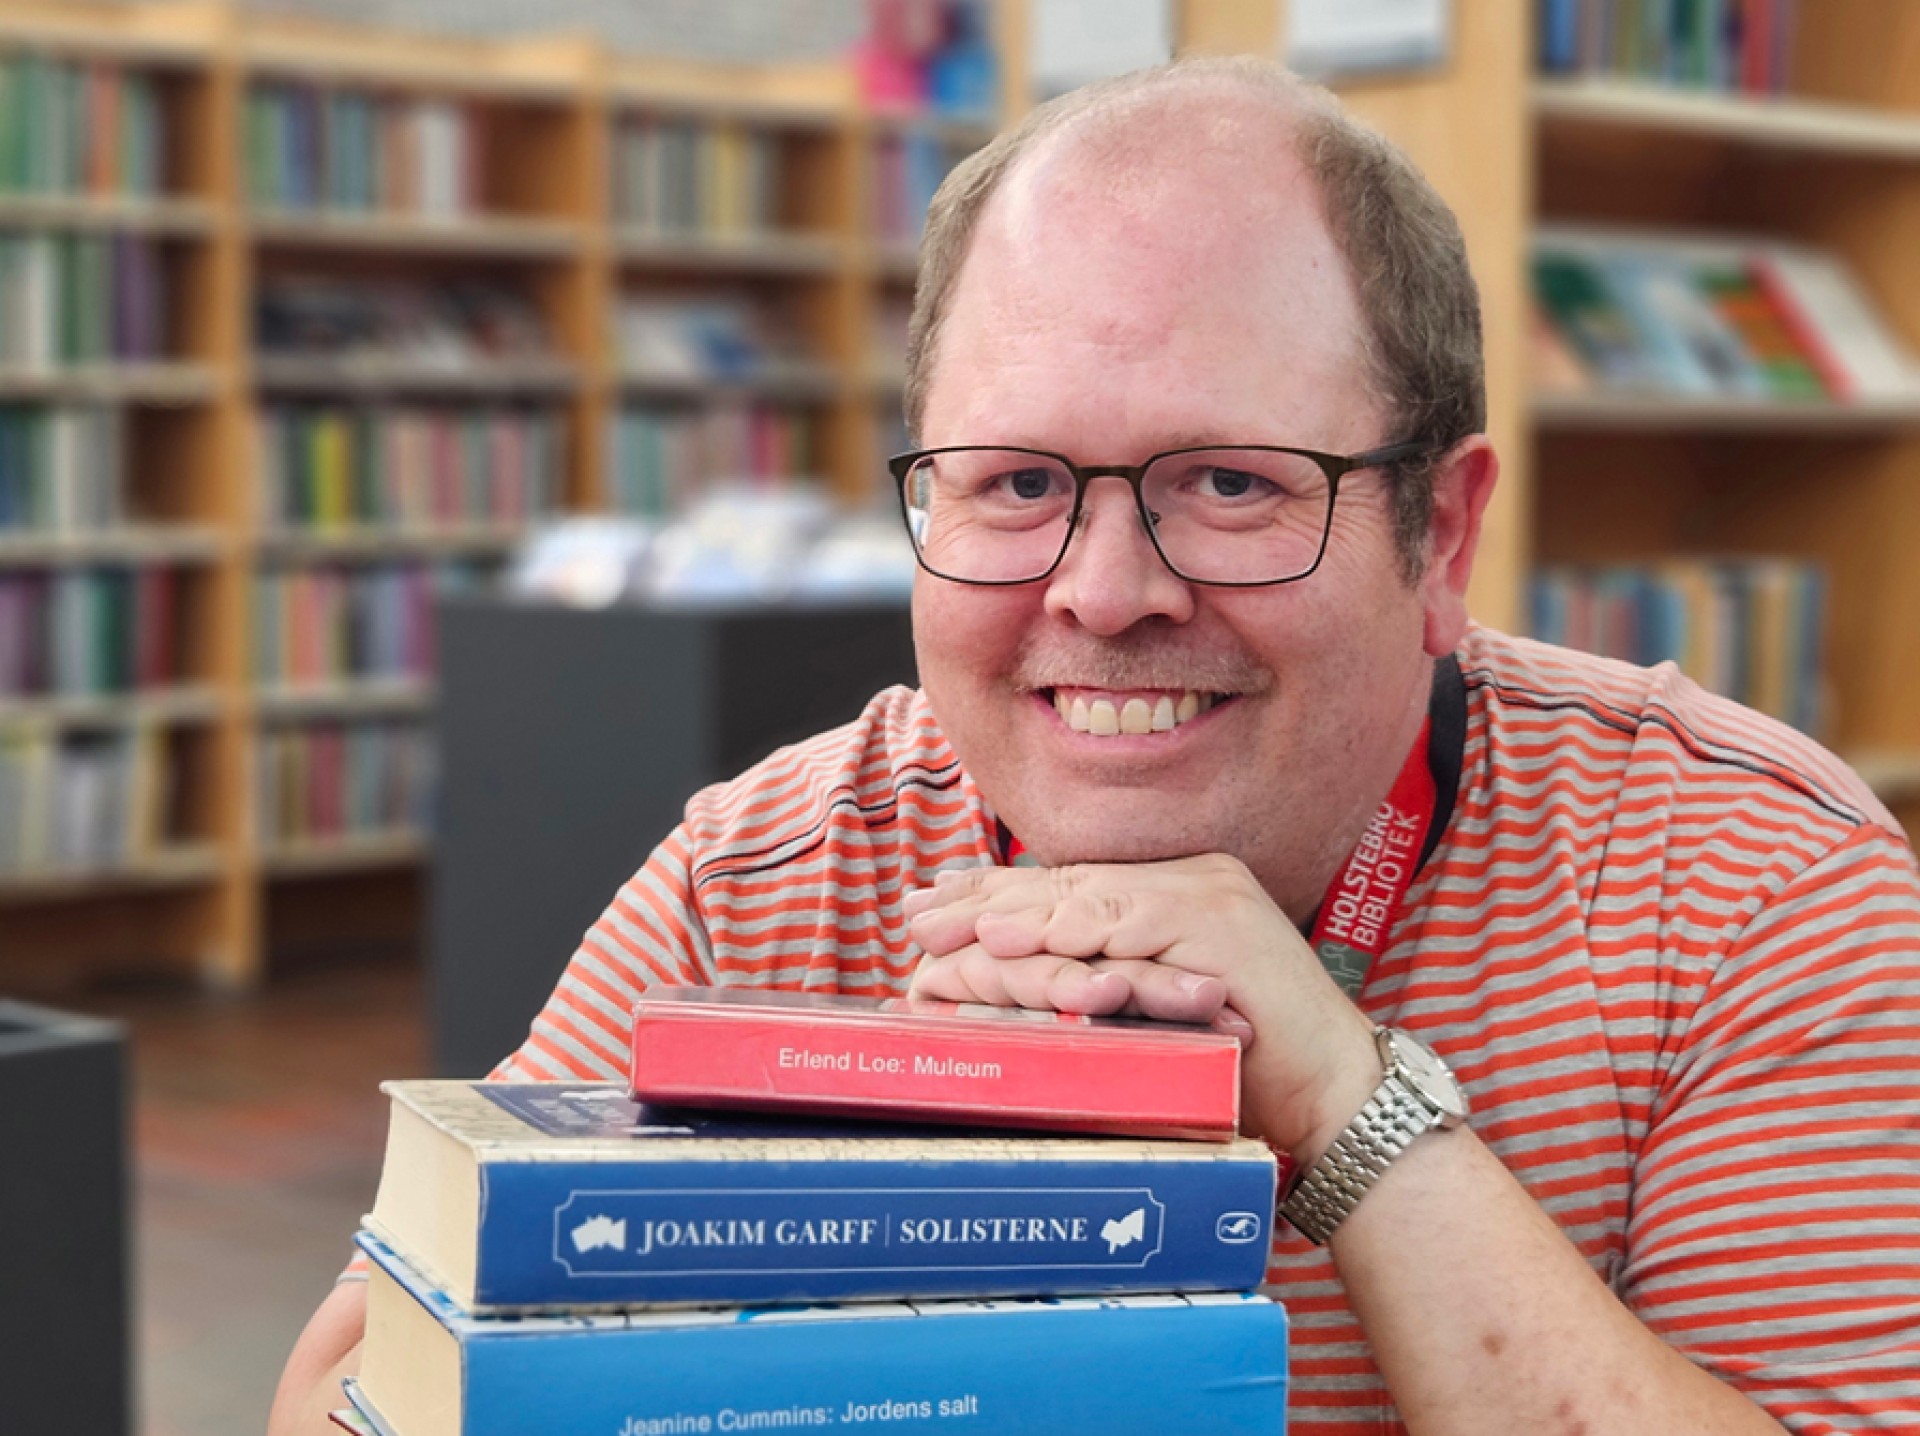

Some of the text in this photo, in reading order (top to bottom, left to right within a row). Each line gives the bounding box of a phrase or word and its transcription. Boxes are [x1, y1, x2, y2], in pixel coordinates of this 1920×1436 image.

[1352, 811, 1420, 946] BIBLIOTEK
[779, 1047, 1002, 1078] Erlend Loe: Muleum
[636, 1217, 1088, 1255] JOAKIM GARFF SOLISTERNE
[618, 1394, 978, 1436] Jeanine Cummins: Jordens salt
